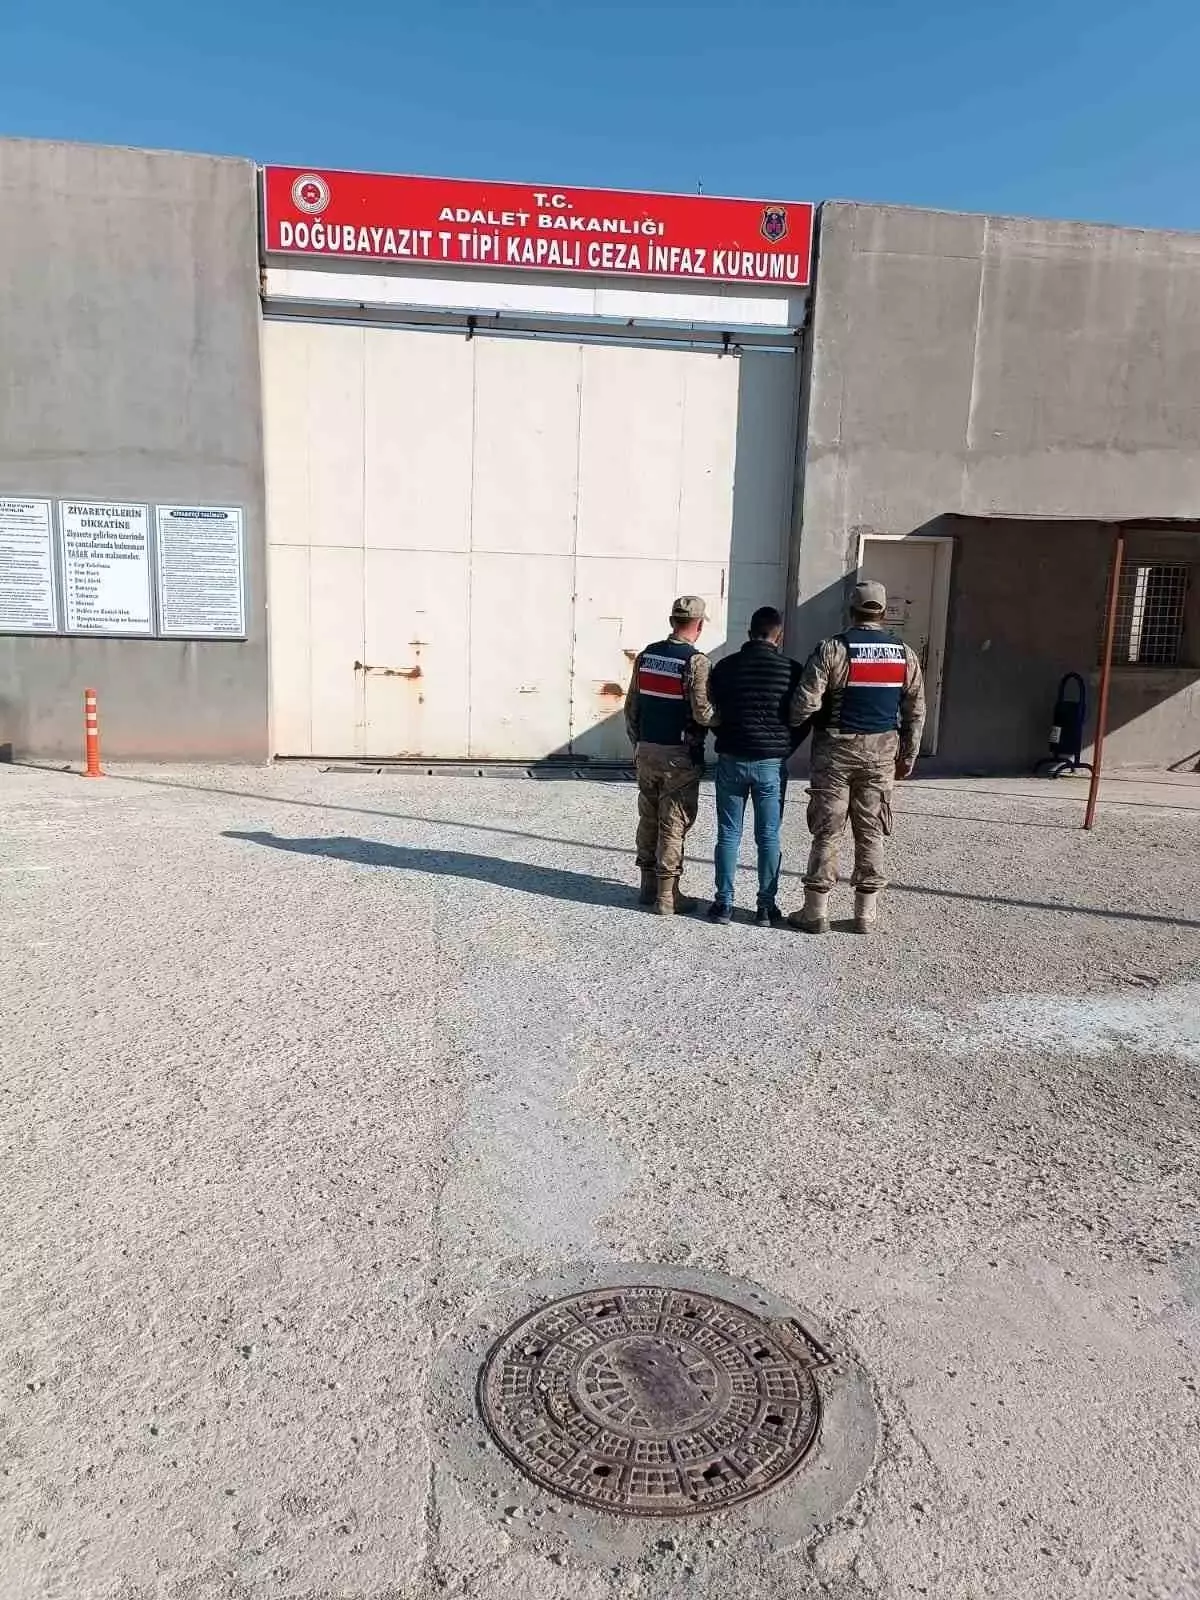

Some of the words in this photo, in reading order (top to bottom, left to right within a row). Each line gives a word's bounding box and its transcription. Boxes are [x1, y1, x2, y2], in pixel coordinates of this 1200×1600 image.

[533, 193, 573, 209] T.C.
[439, 208, 530, 227] ADALET
[538, 214, 664, 236] BAKANLIĞI
[279, 217, 432, 256] DOĞUBAYAZIT
[438, 231, 452, 258] T
[458, 228, 500, 261] TİPİ
[507, 237, 580, 266] KAPALI
[587, 242, 640, 270] CEZA
[648, 239, 705, 274] İNFAZ
[712, 250, 799, 279] KURUMU
[67, 505, 142, 518] ZİYARETÇİLERİN
[80, 518, 130, 529] DİKKATİNE
[856, 647, 902, 659] JANDARMA
